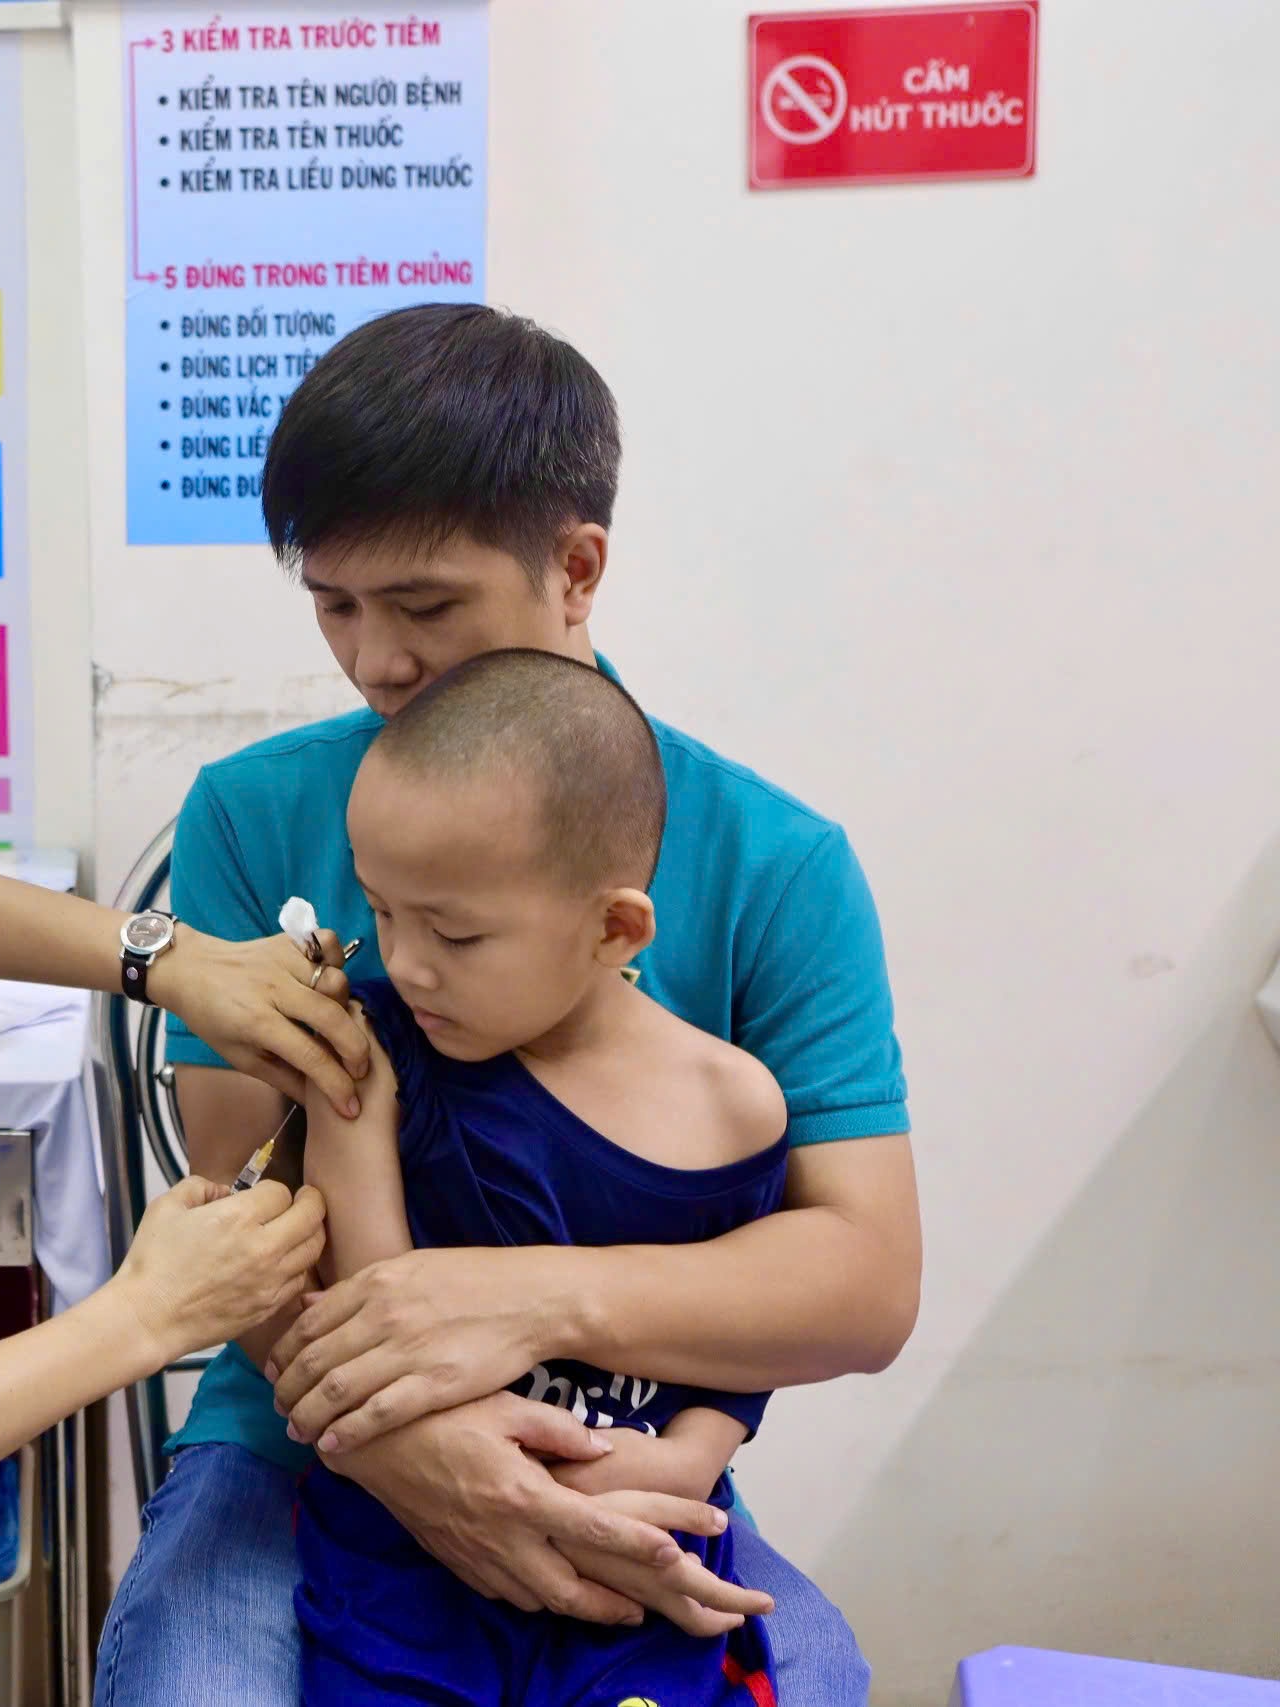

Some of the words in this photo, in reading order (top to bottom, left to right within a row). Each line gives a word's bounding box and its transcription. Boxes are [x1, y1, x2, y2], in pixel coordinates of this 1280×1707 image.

[160, 29, 174, 53] 3
[183, 14, 239, 53] KIỂM
[248, 26, 292, 50] TRA
[300, 17, 376, 49] TRƯỚC
[384, 15, 441, 46] TIÊM
[179, 73, 232, 111] KIỂM
[239, 85, 279, 110] TRA
[286, 78, 327, 109] TÊN
[335, 76, 398, 107] NGƯỜI
[406, 75, 462, 112] BỆNH
[903, 58, 970, 94] CẤM
[850, 98, 914, 133] HÚT
[921, 91, 1024, 129] THUỐC
[180, 115, 232, 152] KIỂM
[240, 126, 280, 151] TRA
[287, 119, 327, 149] TÊN
[335, 114, 404, 149] THUỐC
[180, 156, 232, 193] KIỂM
[240, 168, 280, 192] TRA
[288, 156, 332, 190] LIỀU
[342, 160, 397, 189] DÙNG
[405, 154, 473, 189] THUỐC
[163, 265, 177, 290] 5
[185, 258, 245, 289] ĐÚNG
[253, 263, 327, 288] TRONG
[335, 255, 389, 286] TIÊM
[397, 250, 473, 285] CHỦNG
[181, 310, 230, 339] ĐÚNG
[237, 305, 267, 337] ĐỐI
[274, 308, 336, 341] TƯỢNG
[181, 350, 230, 379] ĐÚNG
[237, 355, 277, 385] LỊCH
[285, 349, 322, 376] TIÊ
[181, 389, 230, 419] ĐÚNG
[181, 429, 230, 459] ĐÚNG
[237, 425, 269, 458] LIỀ
[181, 470, 230, 499] ĐÚNG
